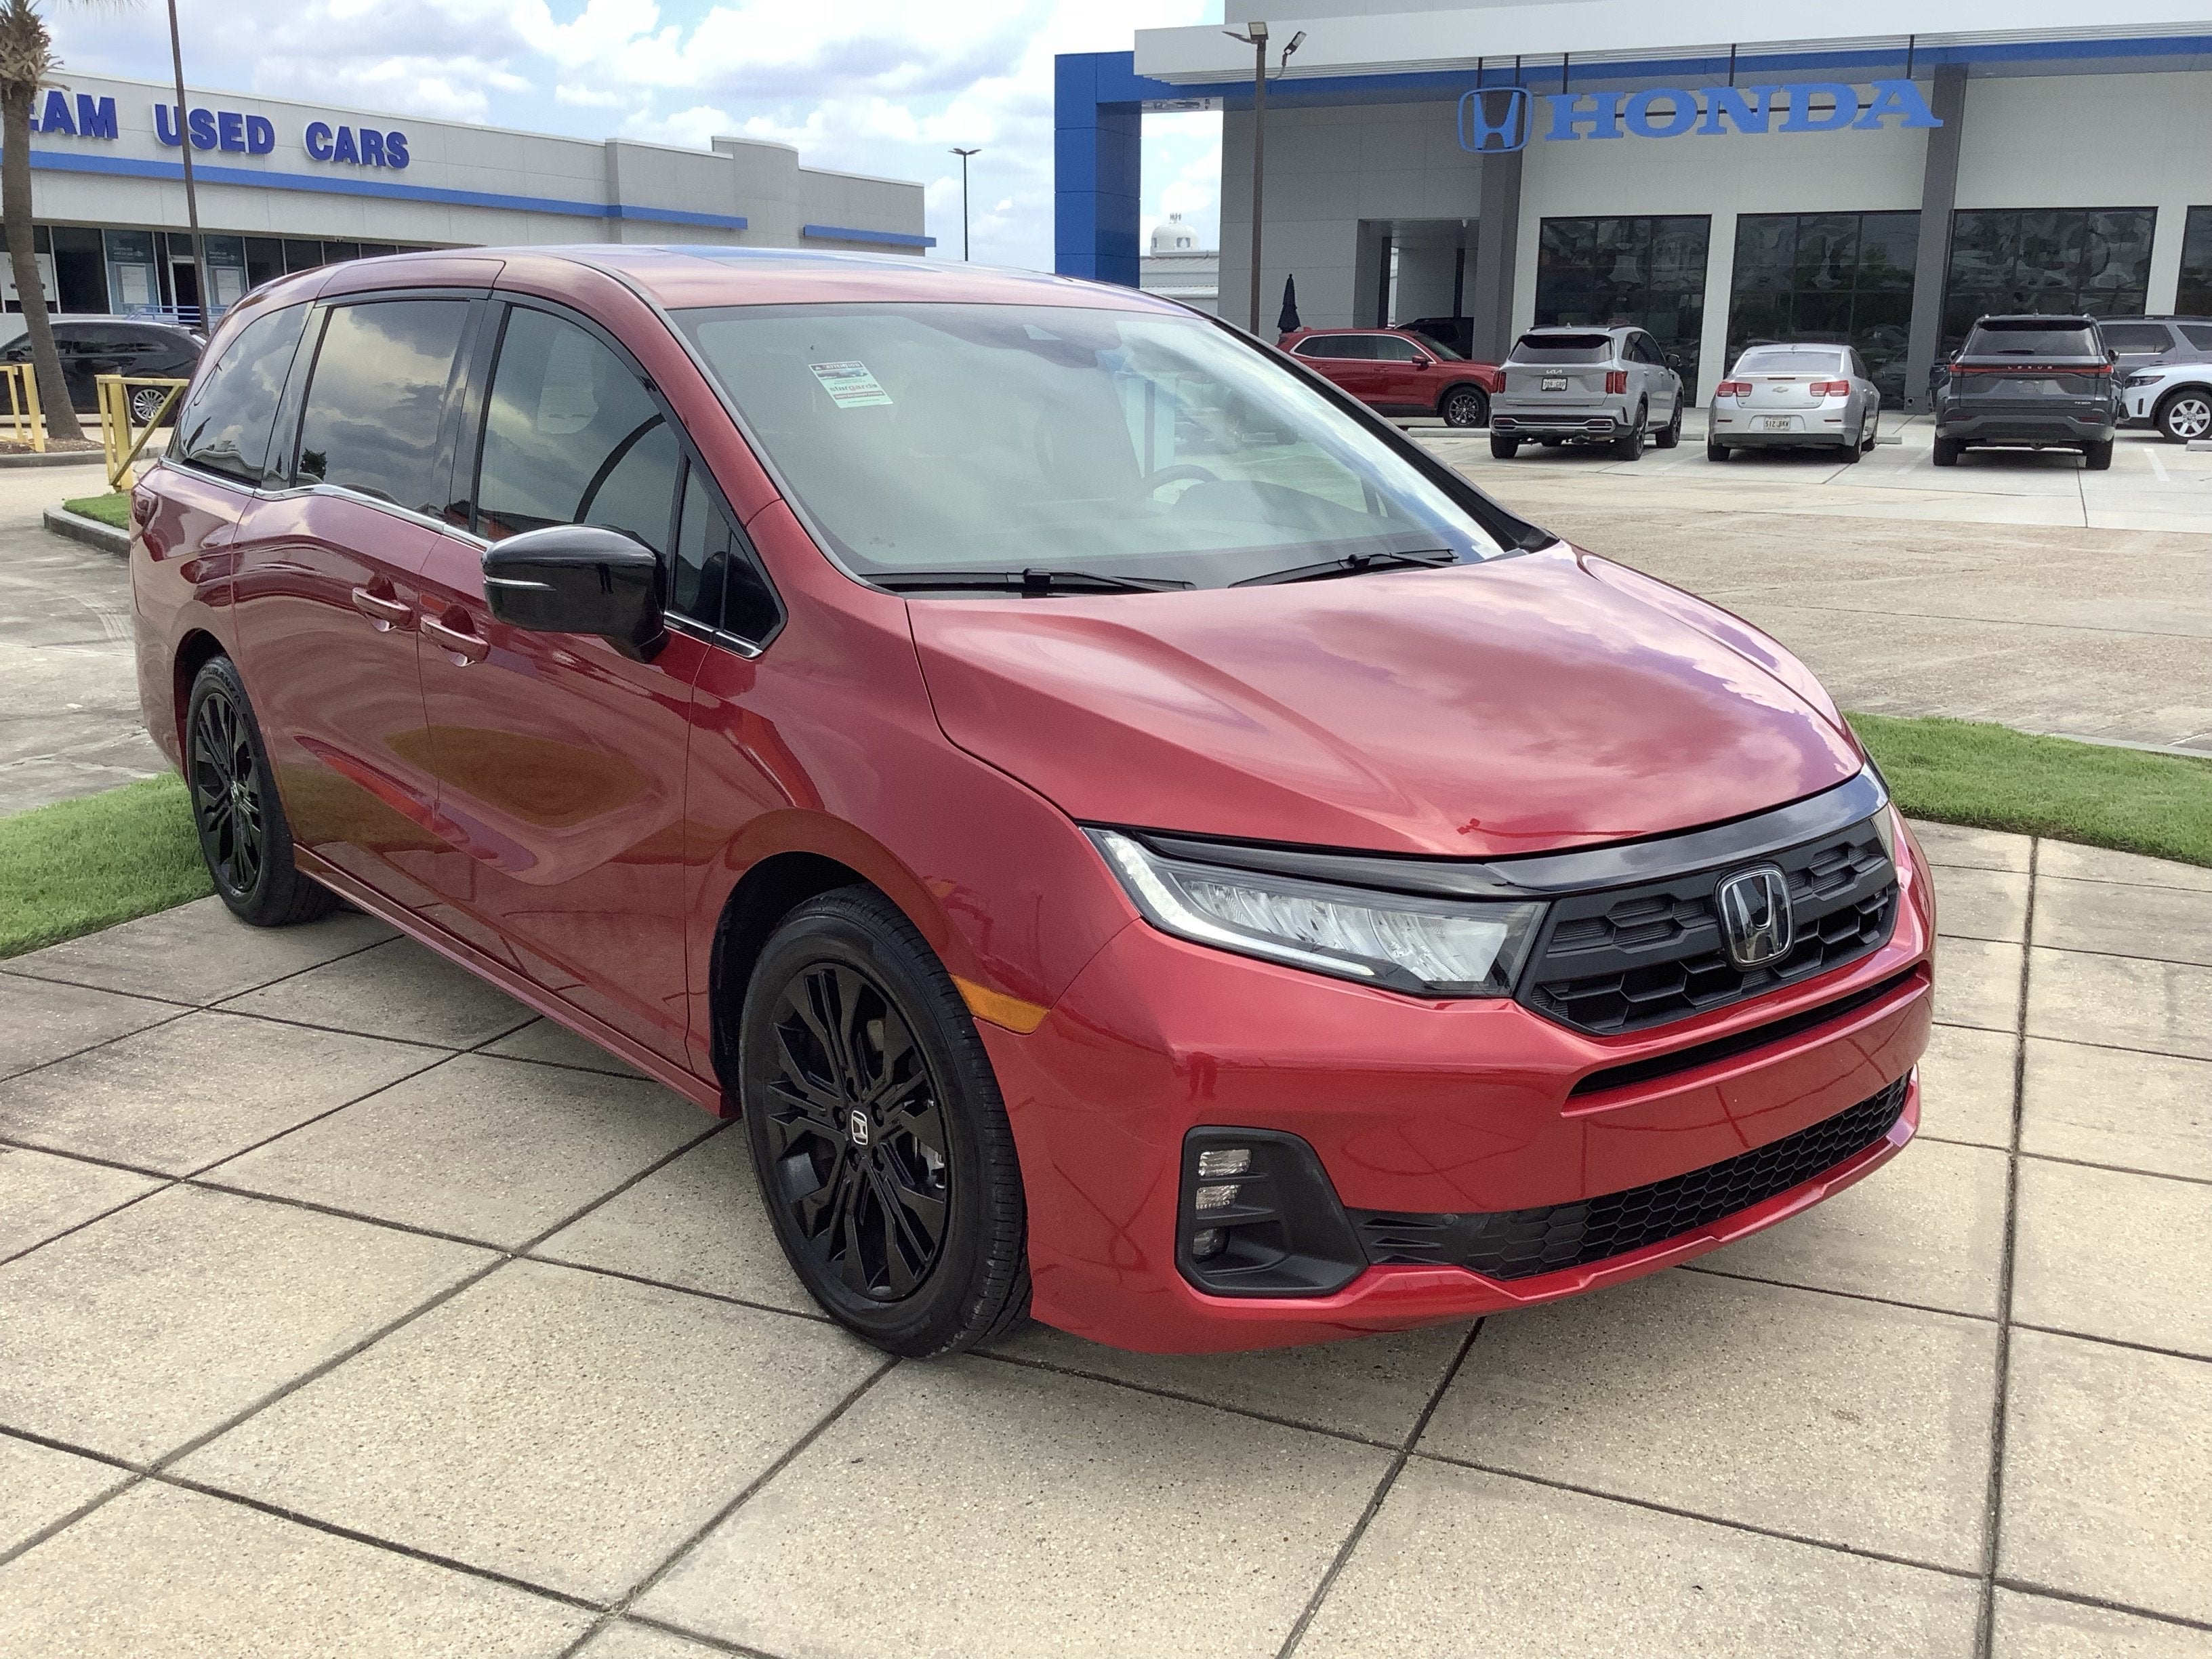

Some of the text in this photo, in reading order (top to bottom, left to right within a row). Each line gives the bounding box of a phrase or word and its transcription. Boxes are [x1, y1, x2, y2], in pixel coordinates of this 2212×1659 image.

[155, 104, 275, 155] USED
[306, 121, 409, 169] CARS
[1545, 79, 1944, 140] HONDA
